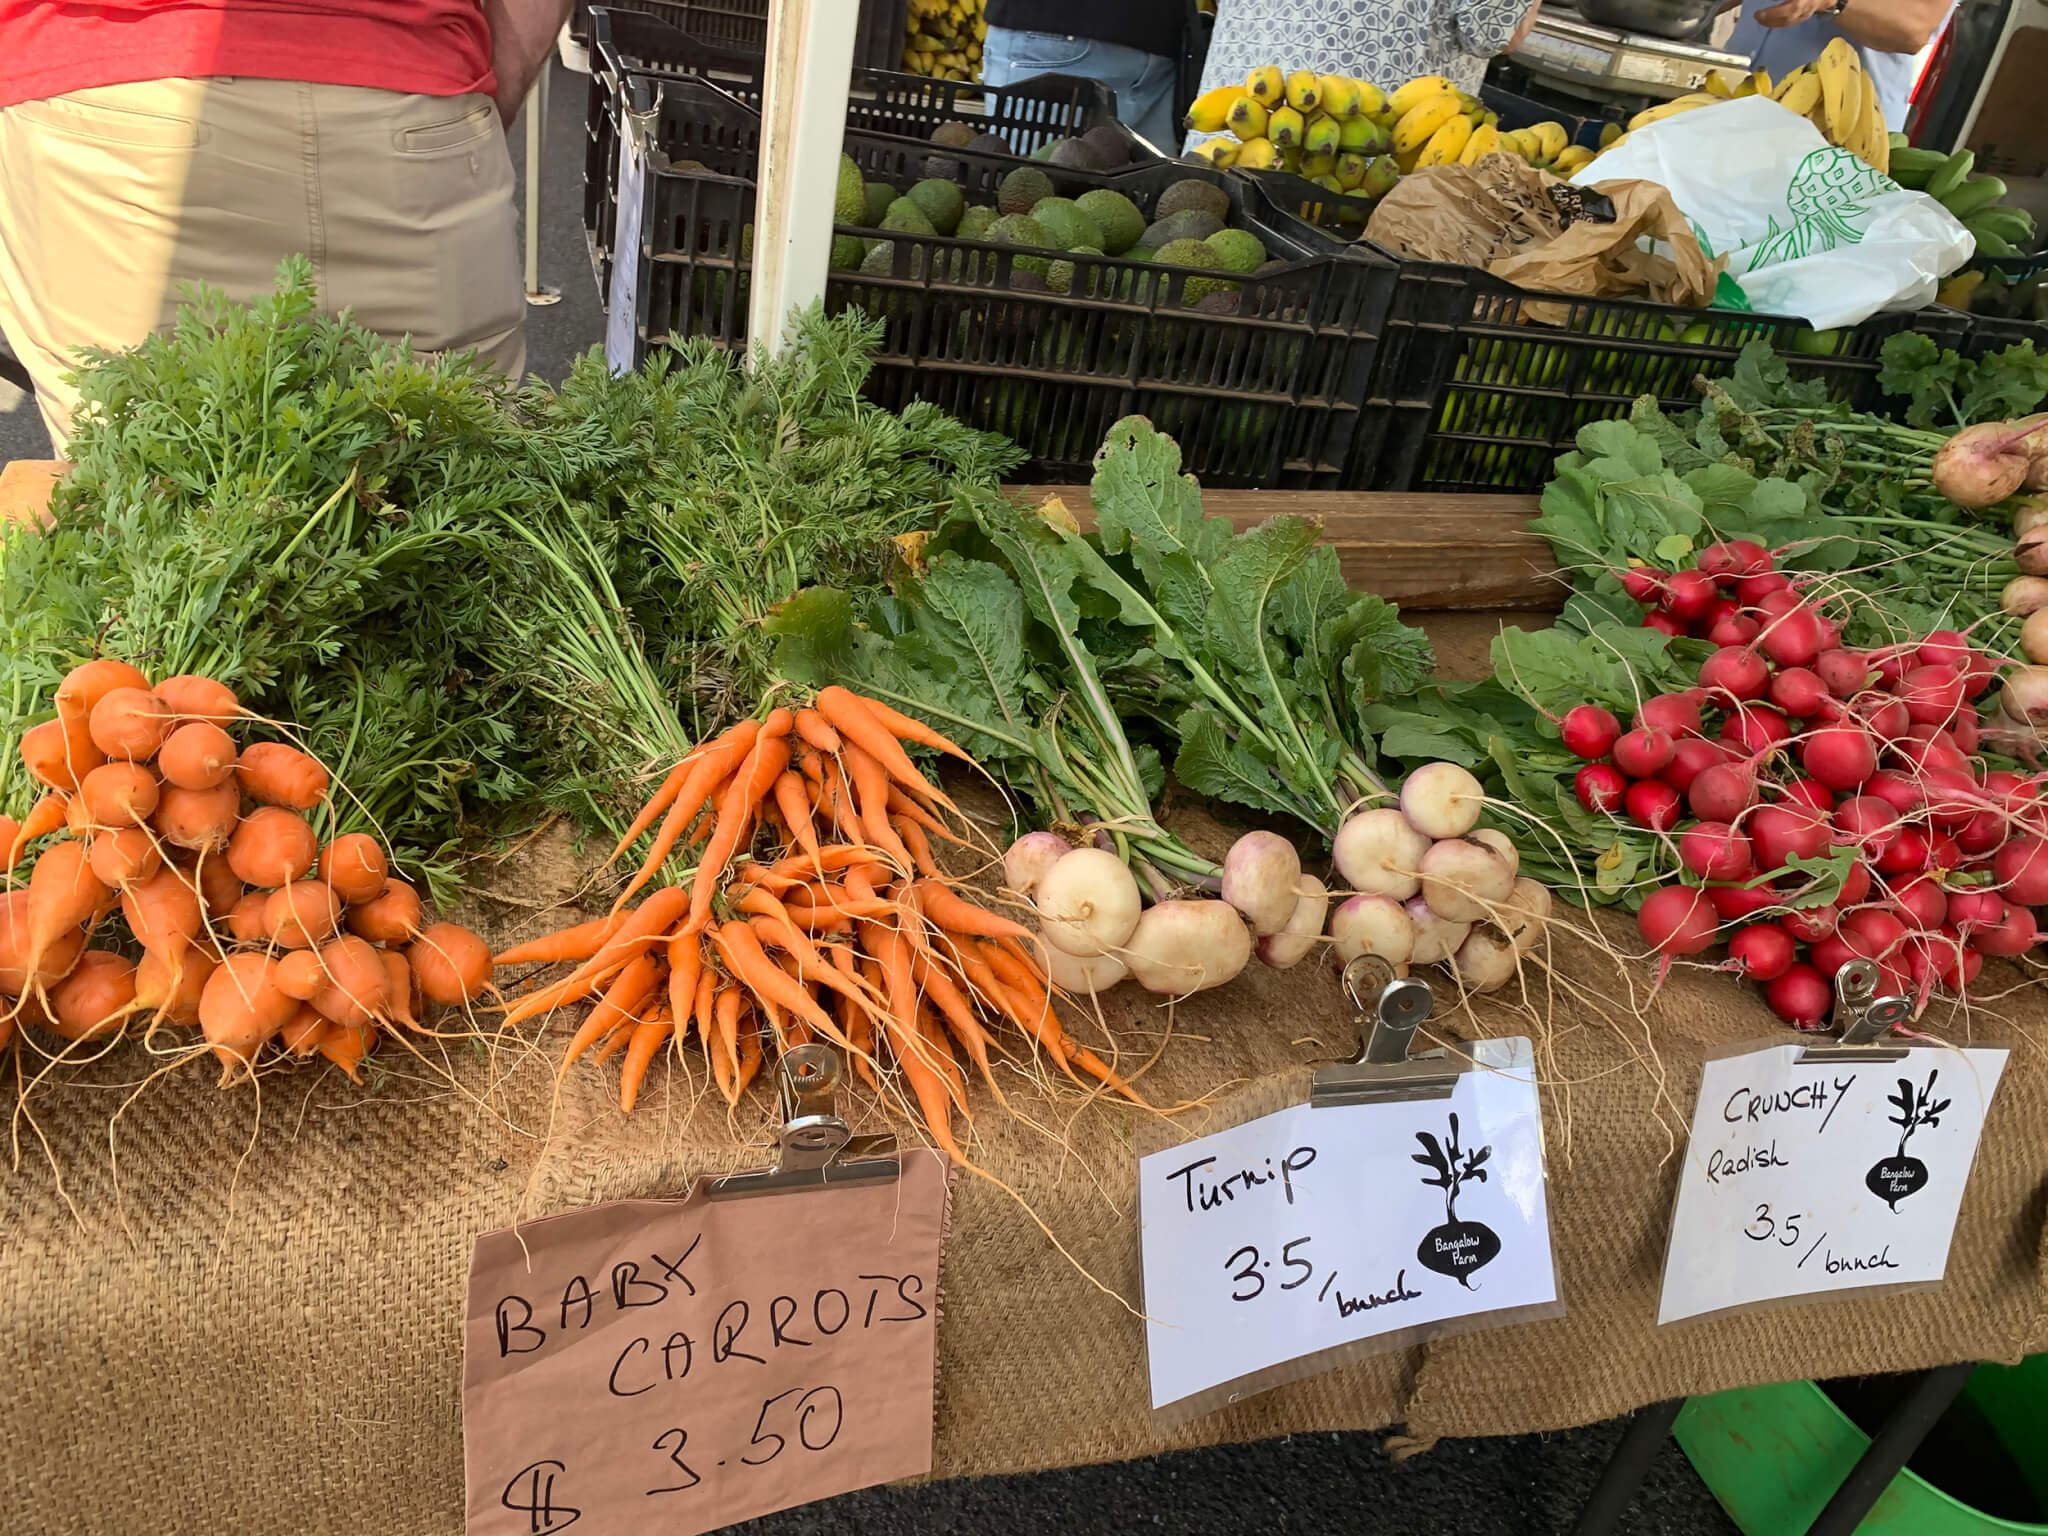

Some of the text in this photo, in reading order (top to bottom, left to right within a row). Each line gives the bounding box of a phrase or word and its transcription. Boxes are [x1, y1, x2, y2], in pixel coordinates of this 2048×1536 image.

[1724, 1074, 1857, 1134] CRUNCHY
[1165, 1146, 1318, 1213] Turnip
[1706, 1139, 1790, 1184] Radish
[1880, 1166, 1916, 1184] Bangalow
[1435, 1233, 1480, 1256] Bangalow
[1452, 1250, 1478, 1266] Farm
[608, 1273, 928, 1397] CARROTS
